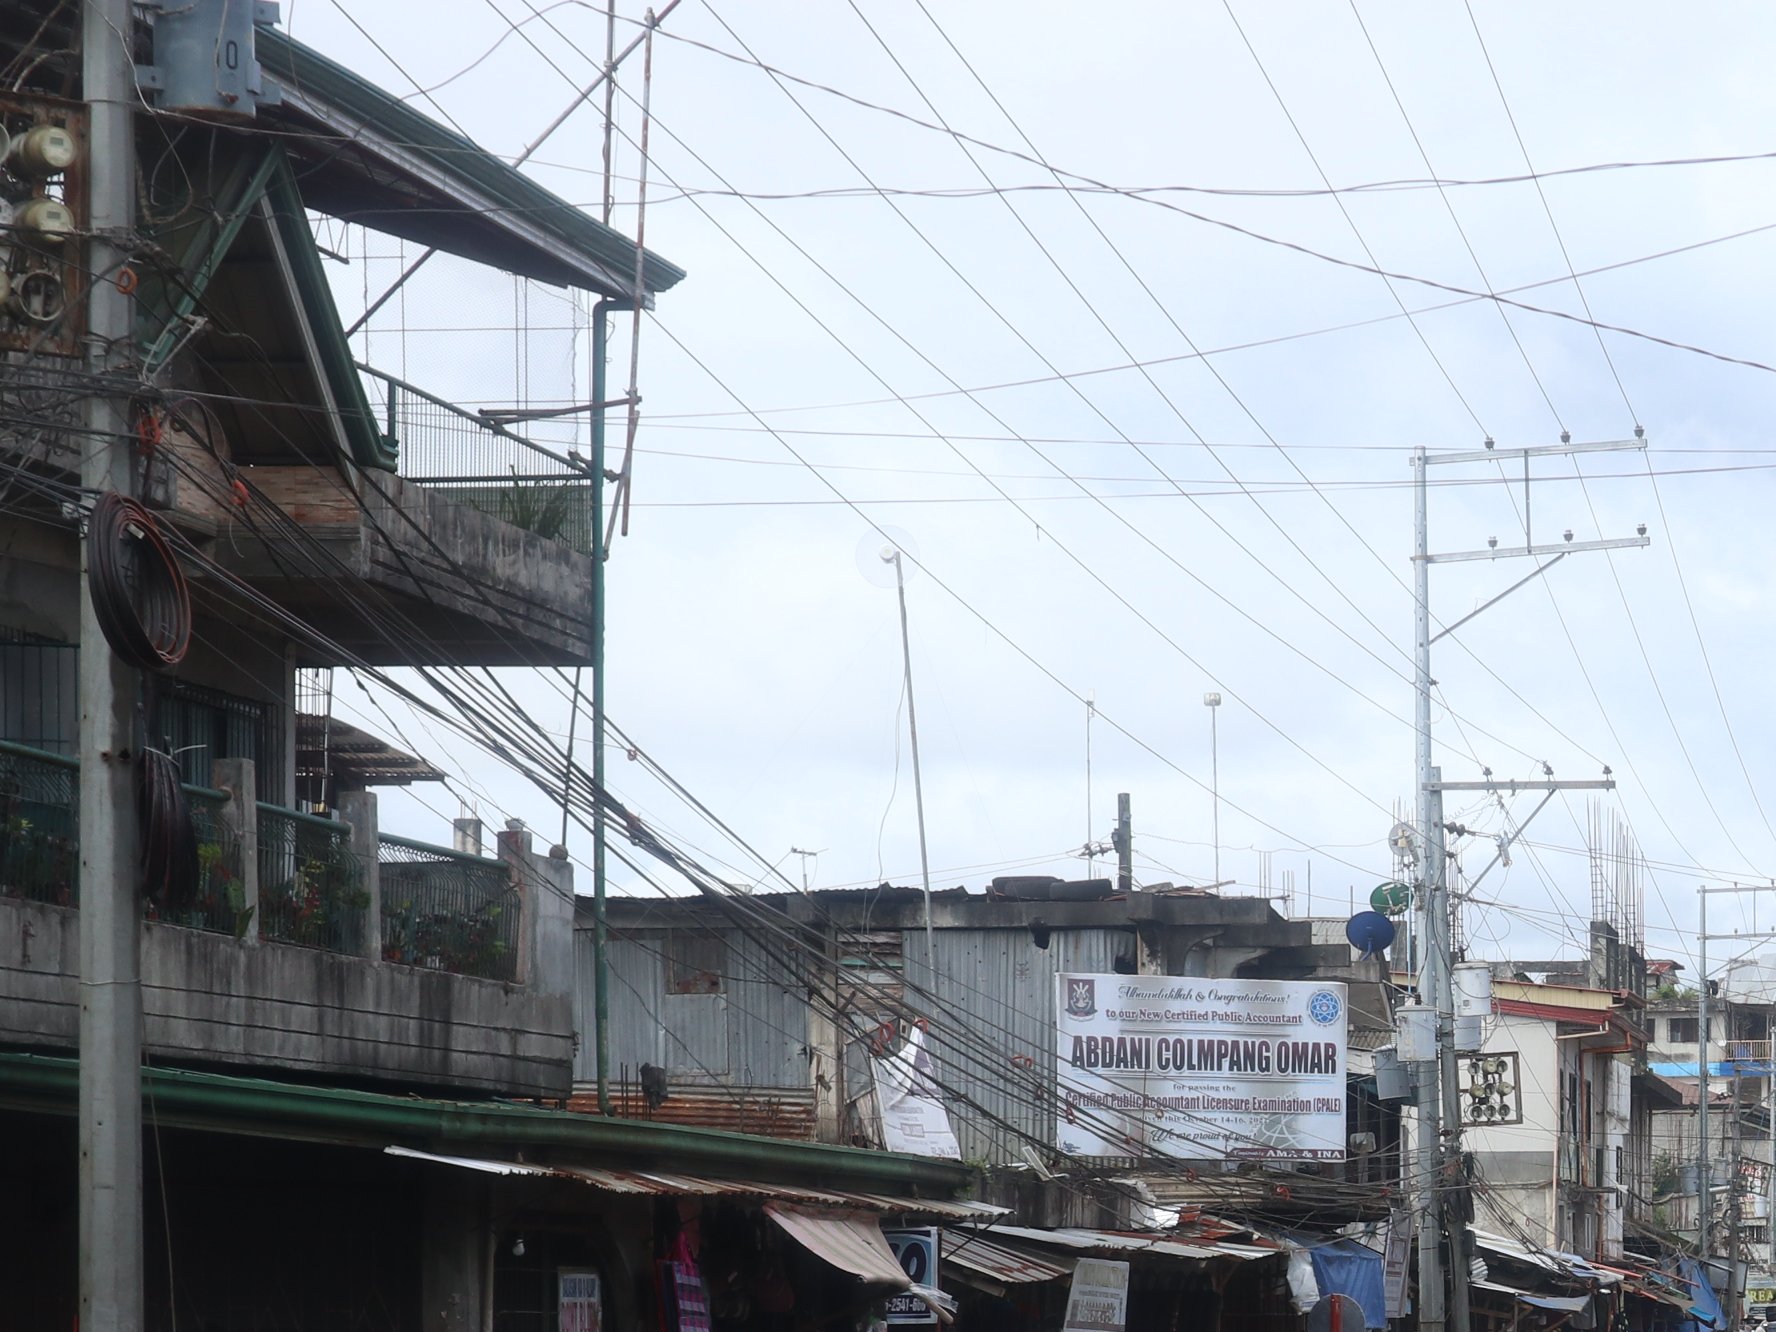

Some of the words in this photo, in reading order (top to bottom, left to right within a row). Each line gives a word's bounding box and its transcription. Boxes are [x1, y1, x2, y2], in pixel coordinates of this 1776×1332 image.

[1117, 984, 1193, 1001] Alhamdulillah
[1195, 991, 1206, 1003] &
[1207, 988, 1290, 1005] Congratulations!
[1106, 1008, 1117, 1019] to
[1118, 1009, 1137, 1019] our
[1139, 1009, 1162, 1020] New
[1164, 1009, 1209, 1022] Certified
[1211, 1011, 1243, 1023] Public
[1245, 1012, 1303, 1025] Accountant
[1071, 1034, 1151, 1071] ABDANI
[1156, 1036, 1271, 1074] COLMPANG
[1276, 1040, 1338, 1075] OMAR
[1173, 1084, 1186, 1092] for
[1188, 1084, 1221, 1094] passing
[1222, 1084, 1237, 1092] the
[1065, 1091, 1109, 1108] Certified
[1111, 1093, 1141, 1109] Public
[1142, 1093, 1200, 1110] Accountant
[1202, 1095, 1251, 1111] Licensure
[1252, 1096, 1312, 1112] Examination
[1164, 1115, 1181, 1123] this
[1302, 1150, 1313, 1158] &
[1317, 1150, 1342, 1159] INA
